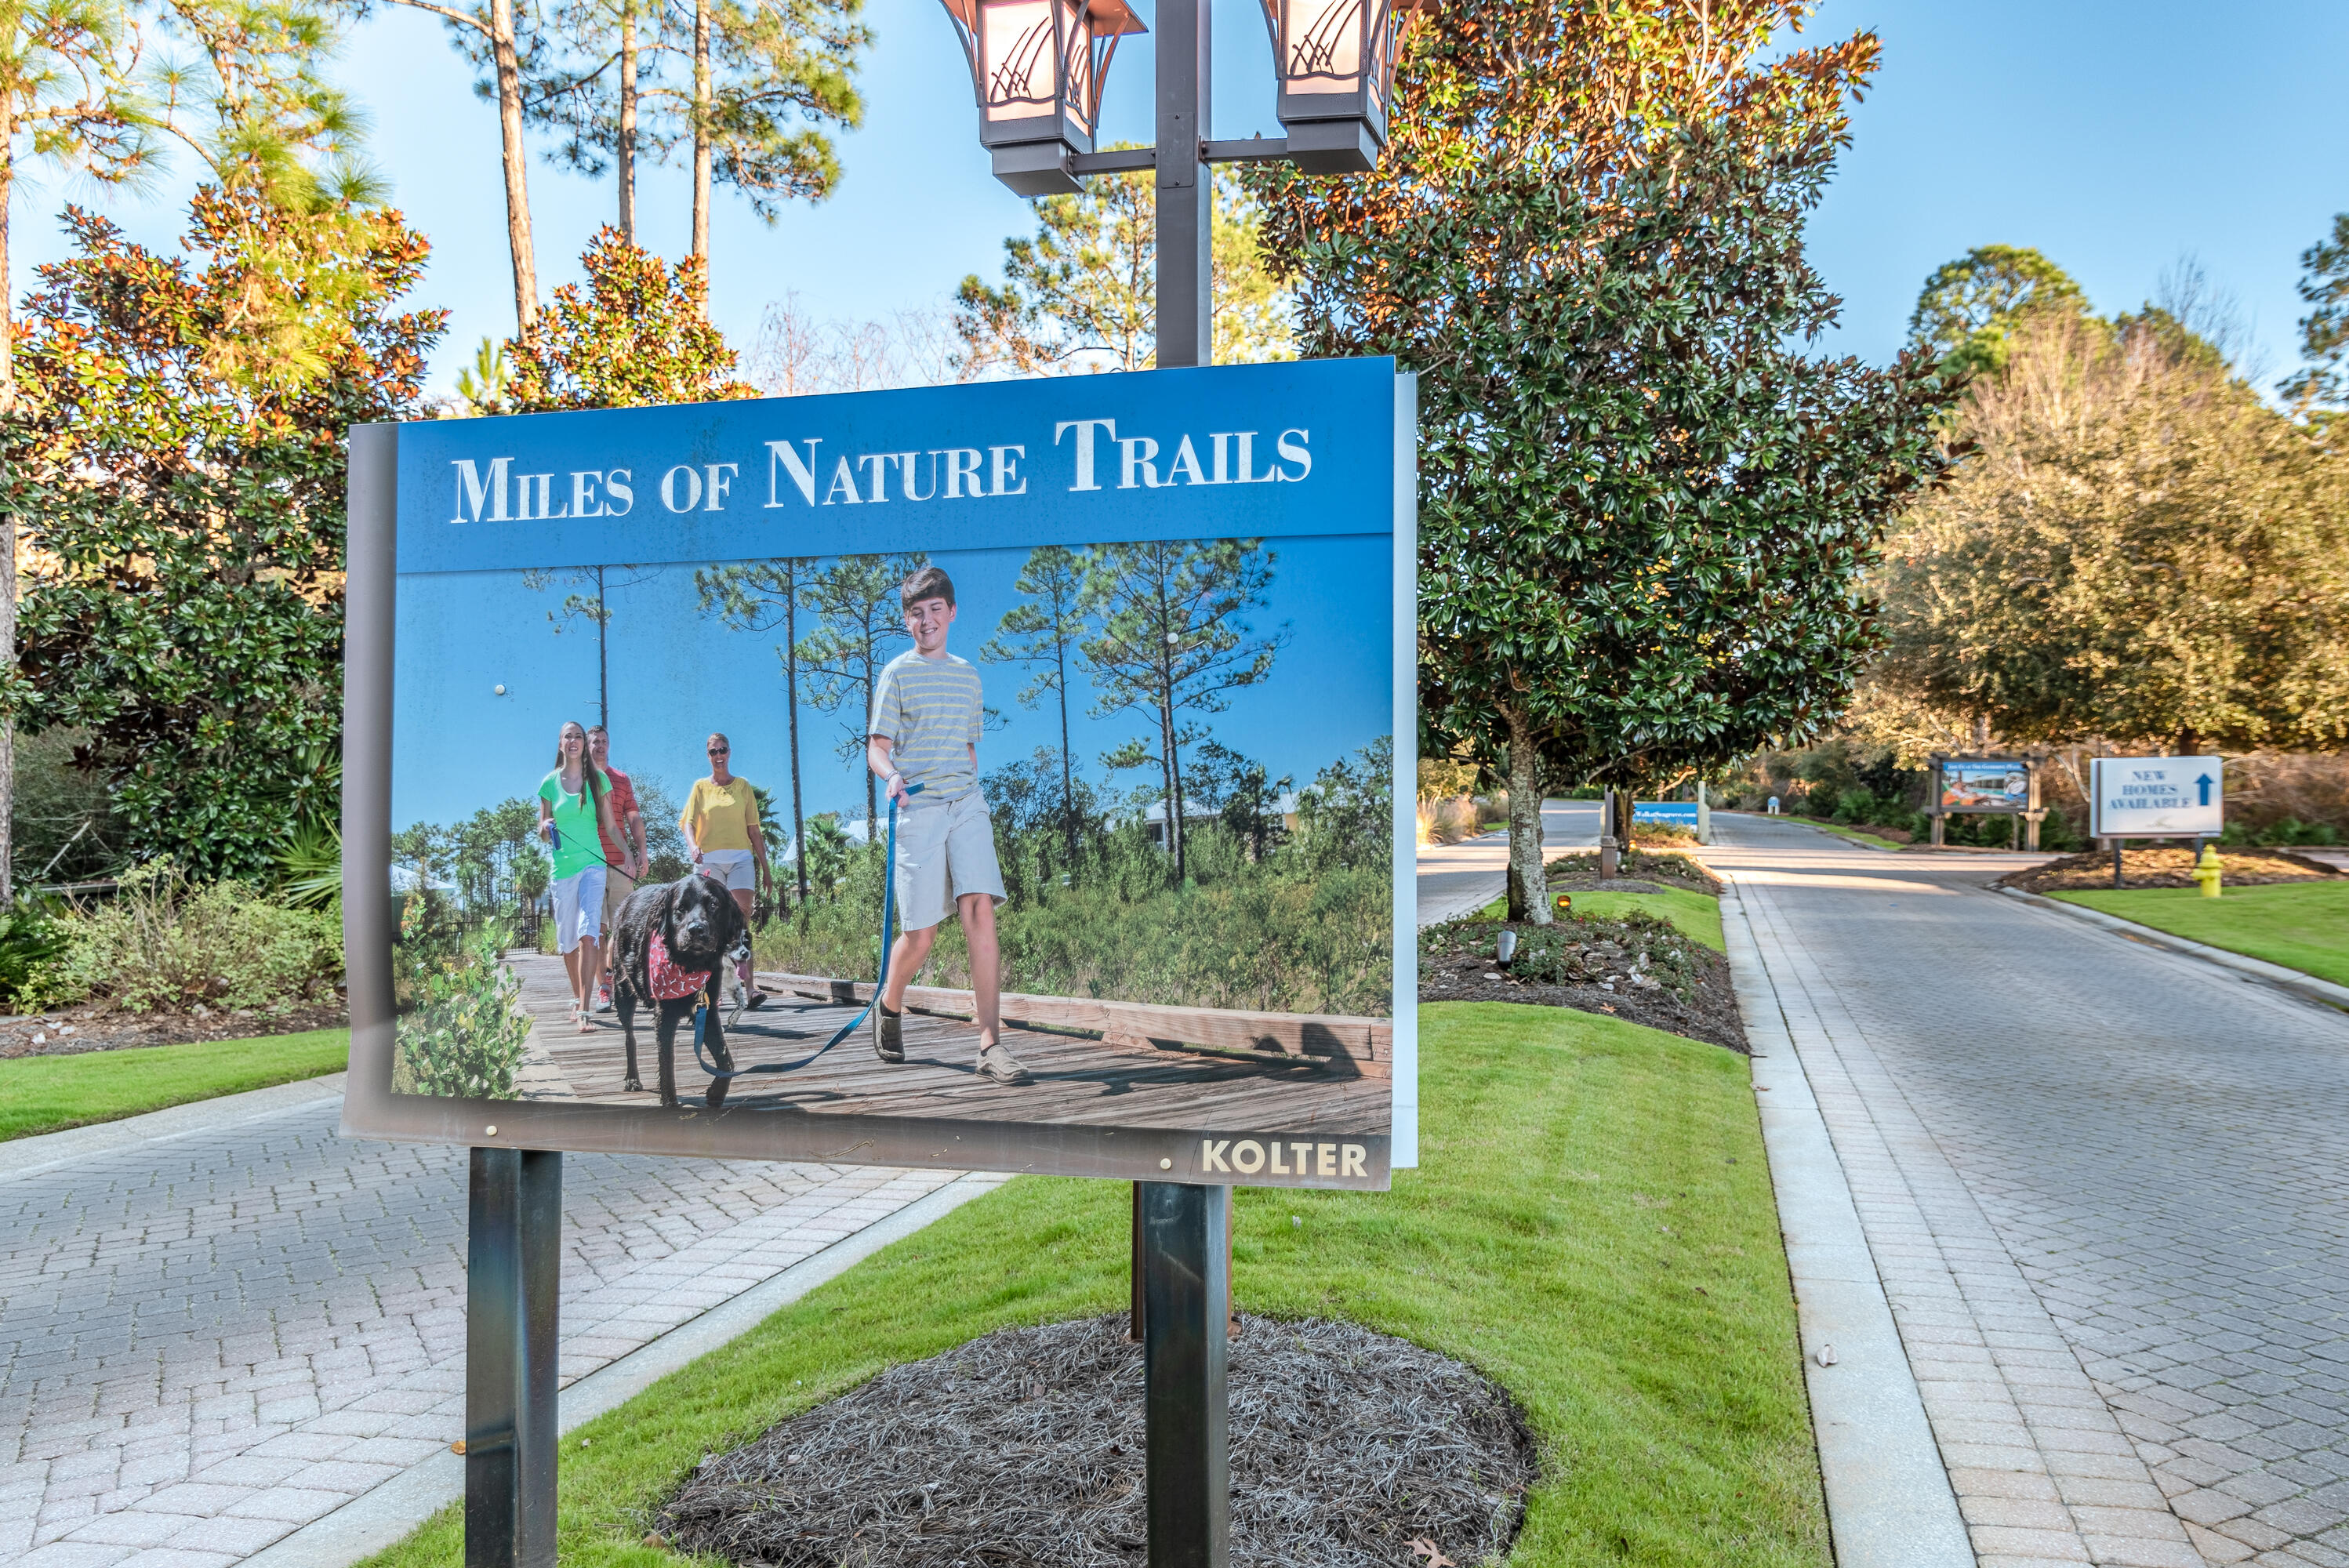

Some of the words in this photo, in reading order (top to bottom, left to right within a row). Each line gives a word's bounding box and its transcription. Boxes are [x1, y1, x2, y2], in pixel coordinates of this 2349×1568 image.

[450, 457, 634, 524] MILES
[661, 463, 739, 514] OF
[764, 438, 1027, 508] NATURE
[1055, 418, 1312, 492] TRAILS
[2133, 771, 2166, 781] NEW
[2122, 785, 2177, 795] HOMES
[2109, 797, 2191, 809] AVAILABLE
[1203, 1139, 1368, 1177] KOLTER
